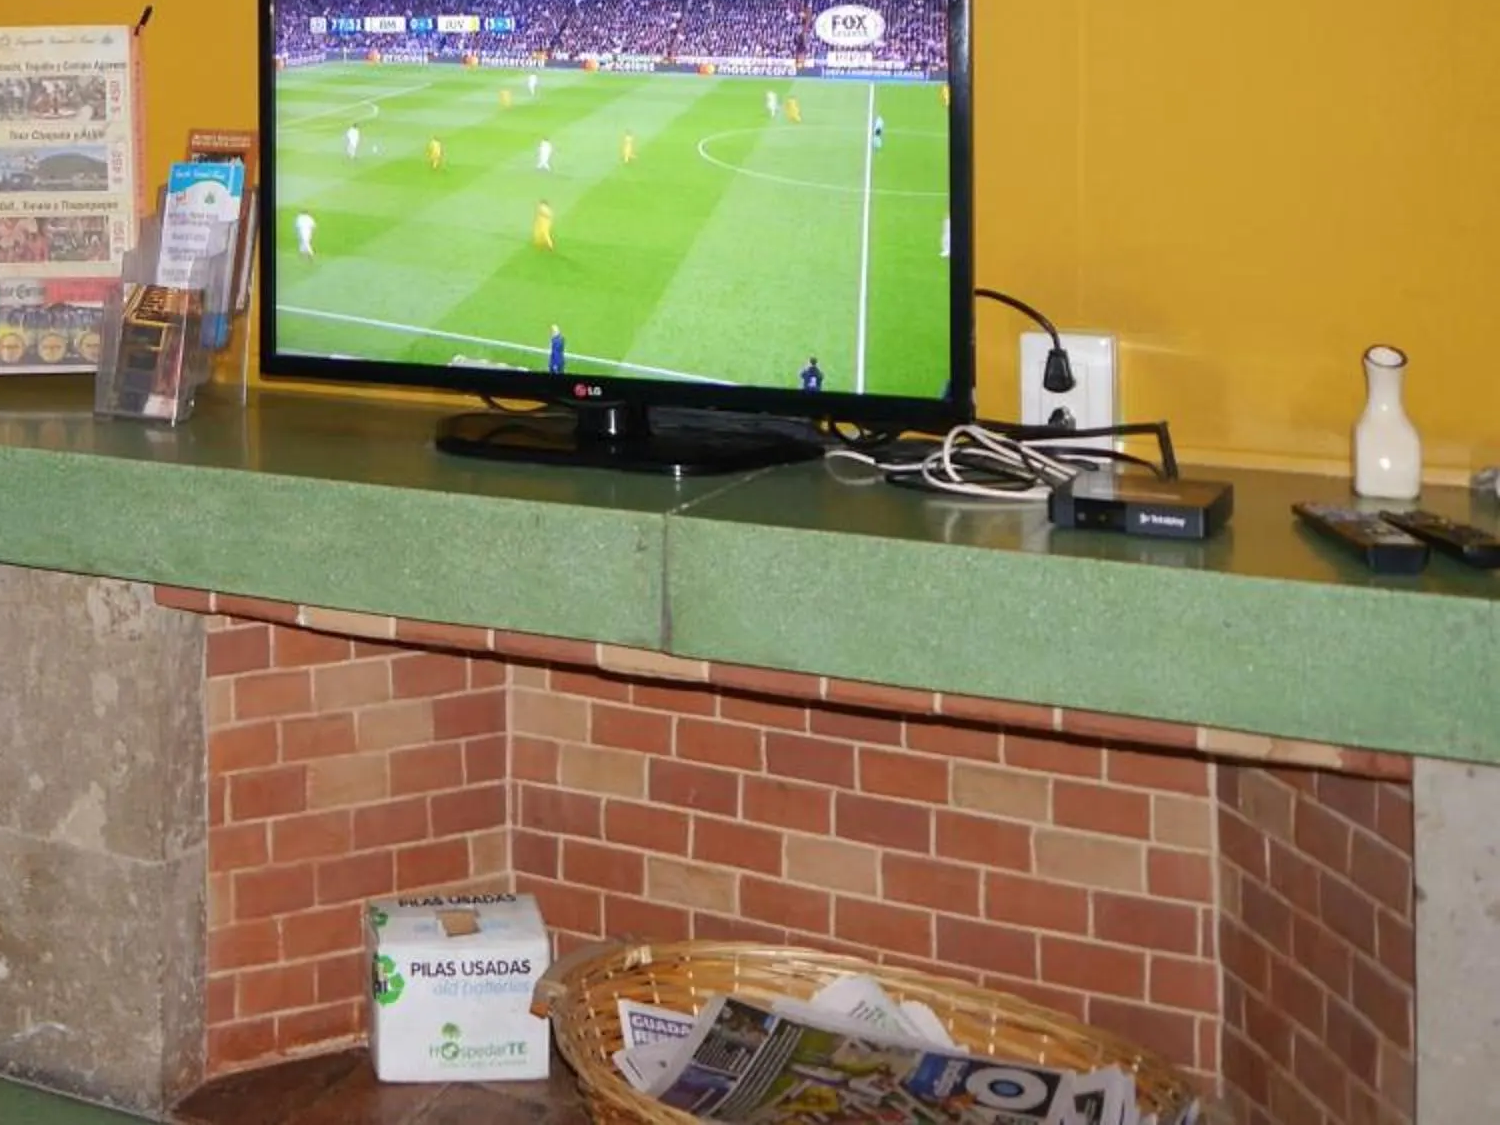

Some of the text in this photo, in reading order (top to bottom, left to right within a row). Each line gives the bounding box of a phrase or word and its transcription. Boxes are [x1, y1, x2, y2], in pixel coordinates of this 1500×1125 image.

[831, 14, 868, 31] FOX
[587, 386, 602, 396] LG
[398, 893, 517, 908] PILAS USADAS
[411, 959, 532, 977] PILAS USADAS
